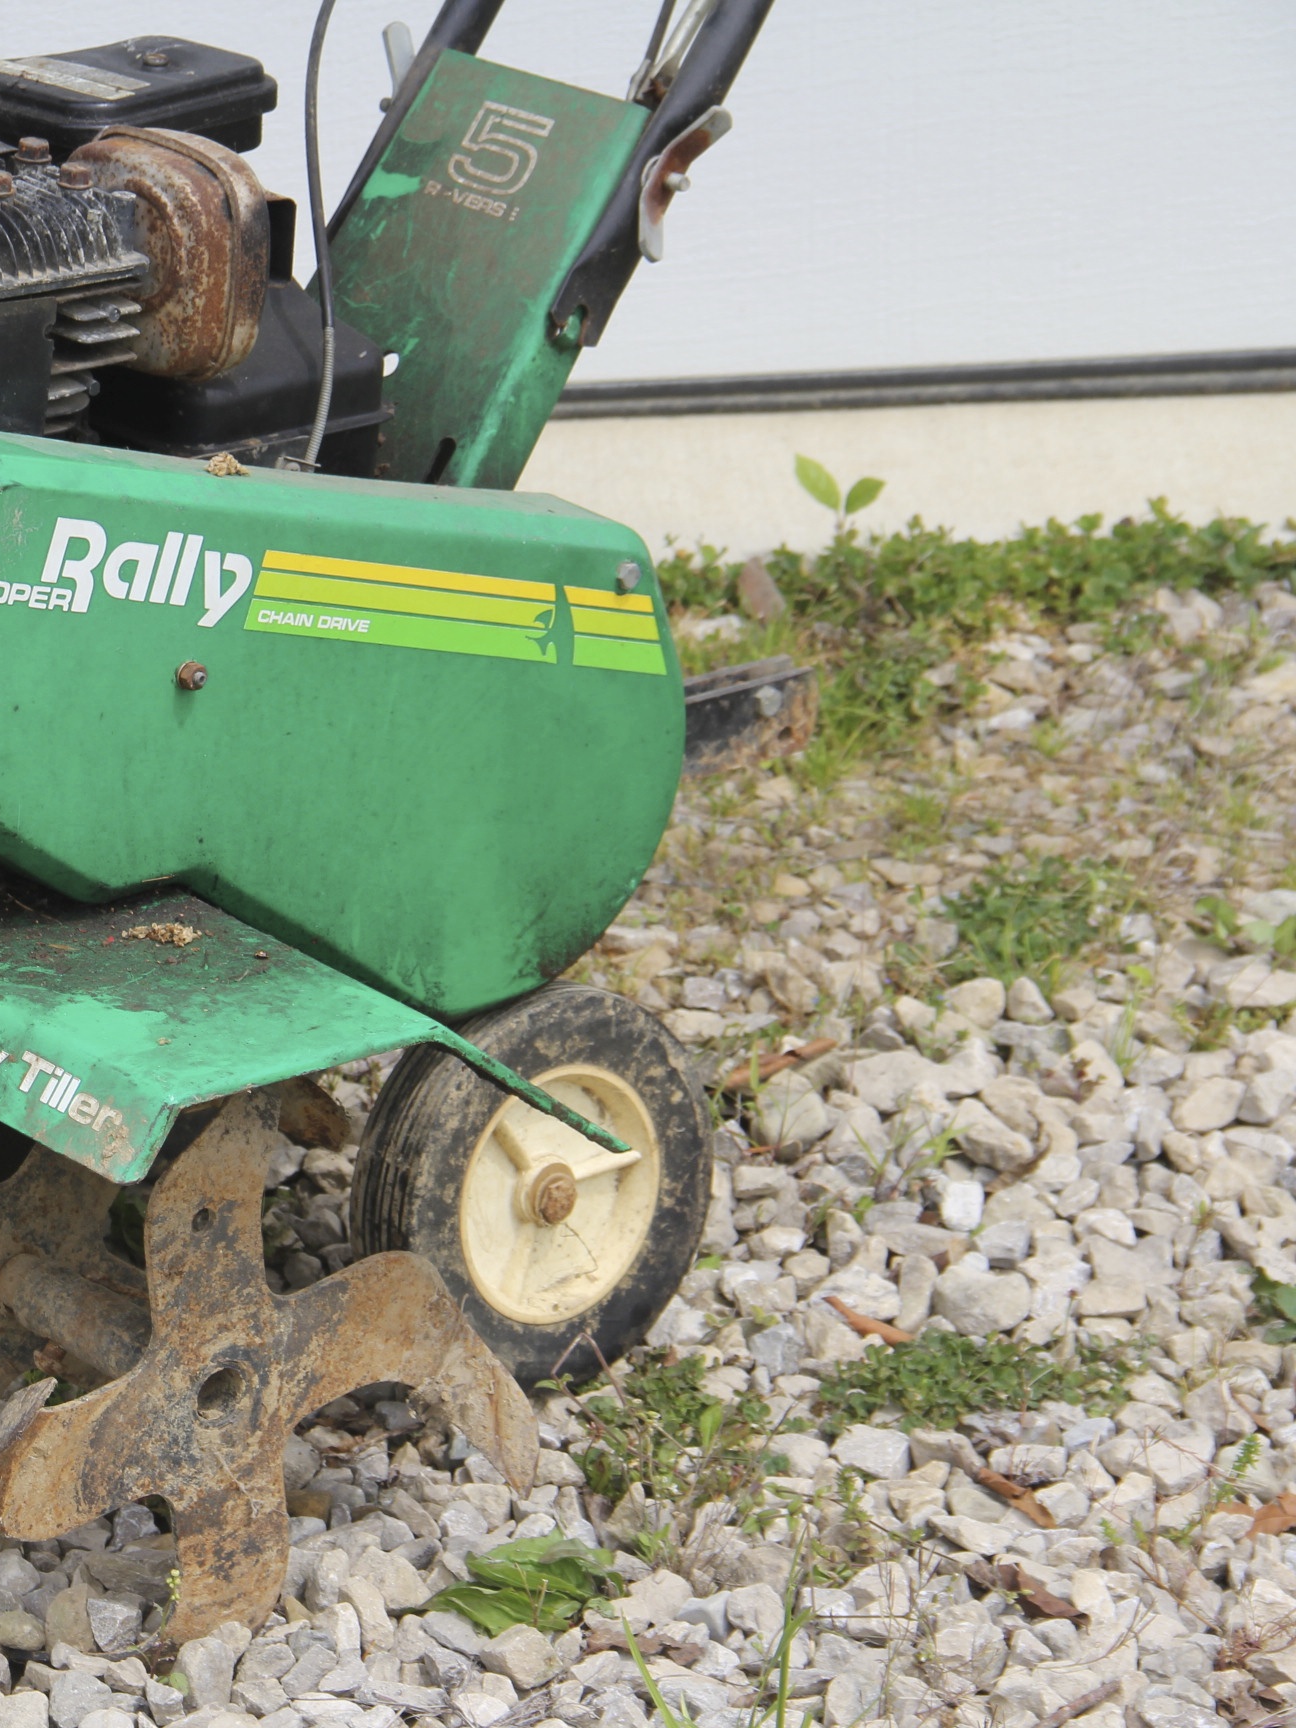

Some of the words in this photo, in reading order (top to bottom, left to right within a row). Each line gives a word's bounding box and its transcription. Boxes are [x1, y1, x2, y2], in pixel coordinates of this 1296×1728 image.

[447, 100, 556, 196] 5
[424, 180, 520, 222] RVERS
[40, 516, 253, 628] Rally
[257, 609, 314, 628] CHAIN
[316, 615, 371, 633] DRIVE
[18, 1050, 123, 1132] Tiller
